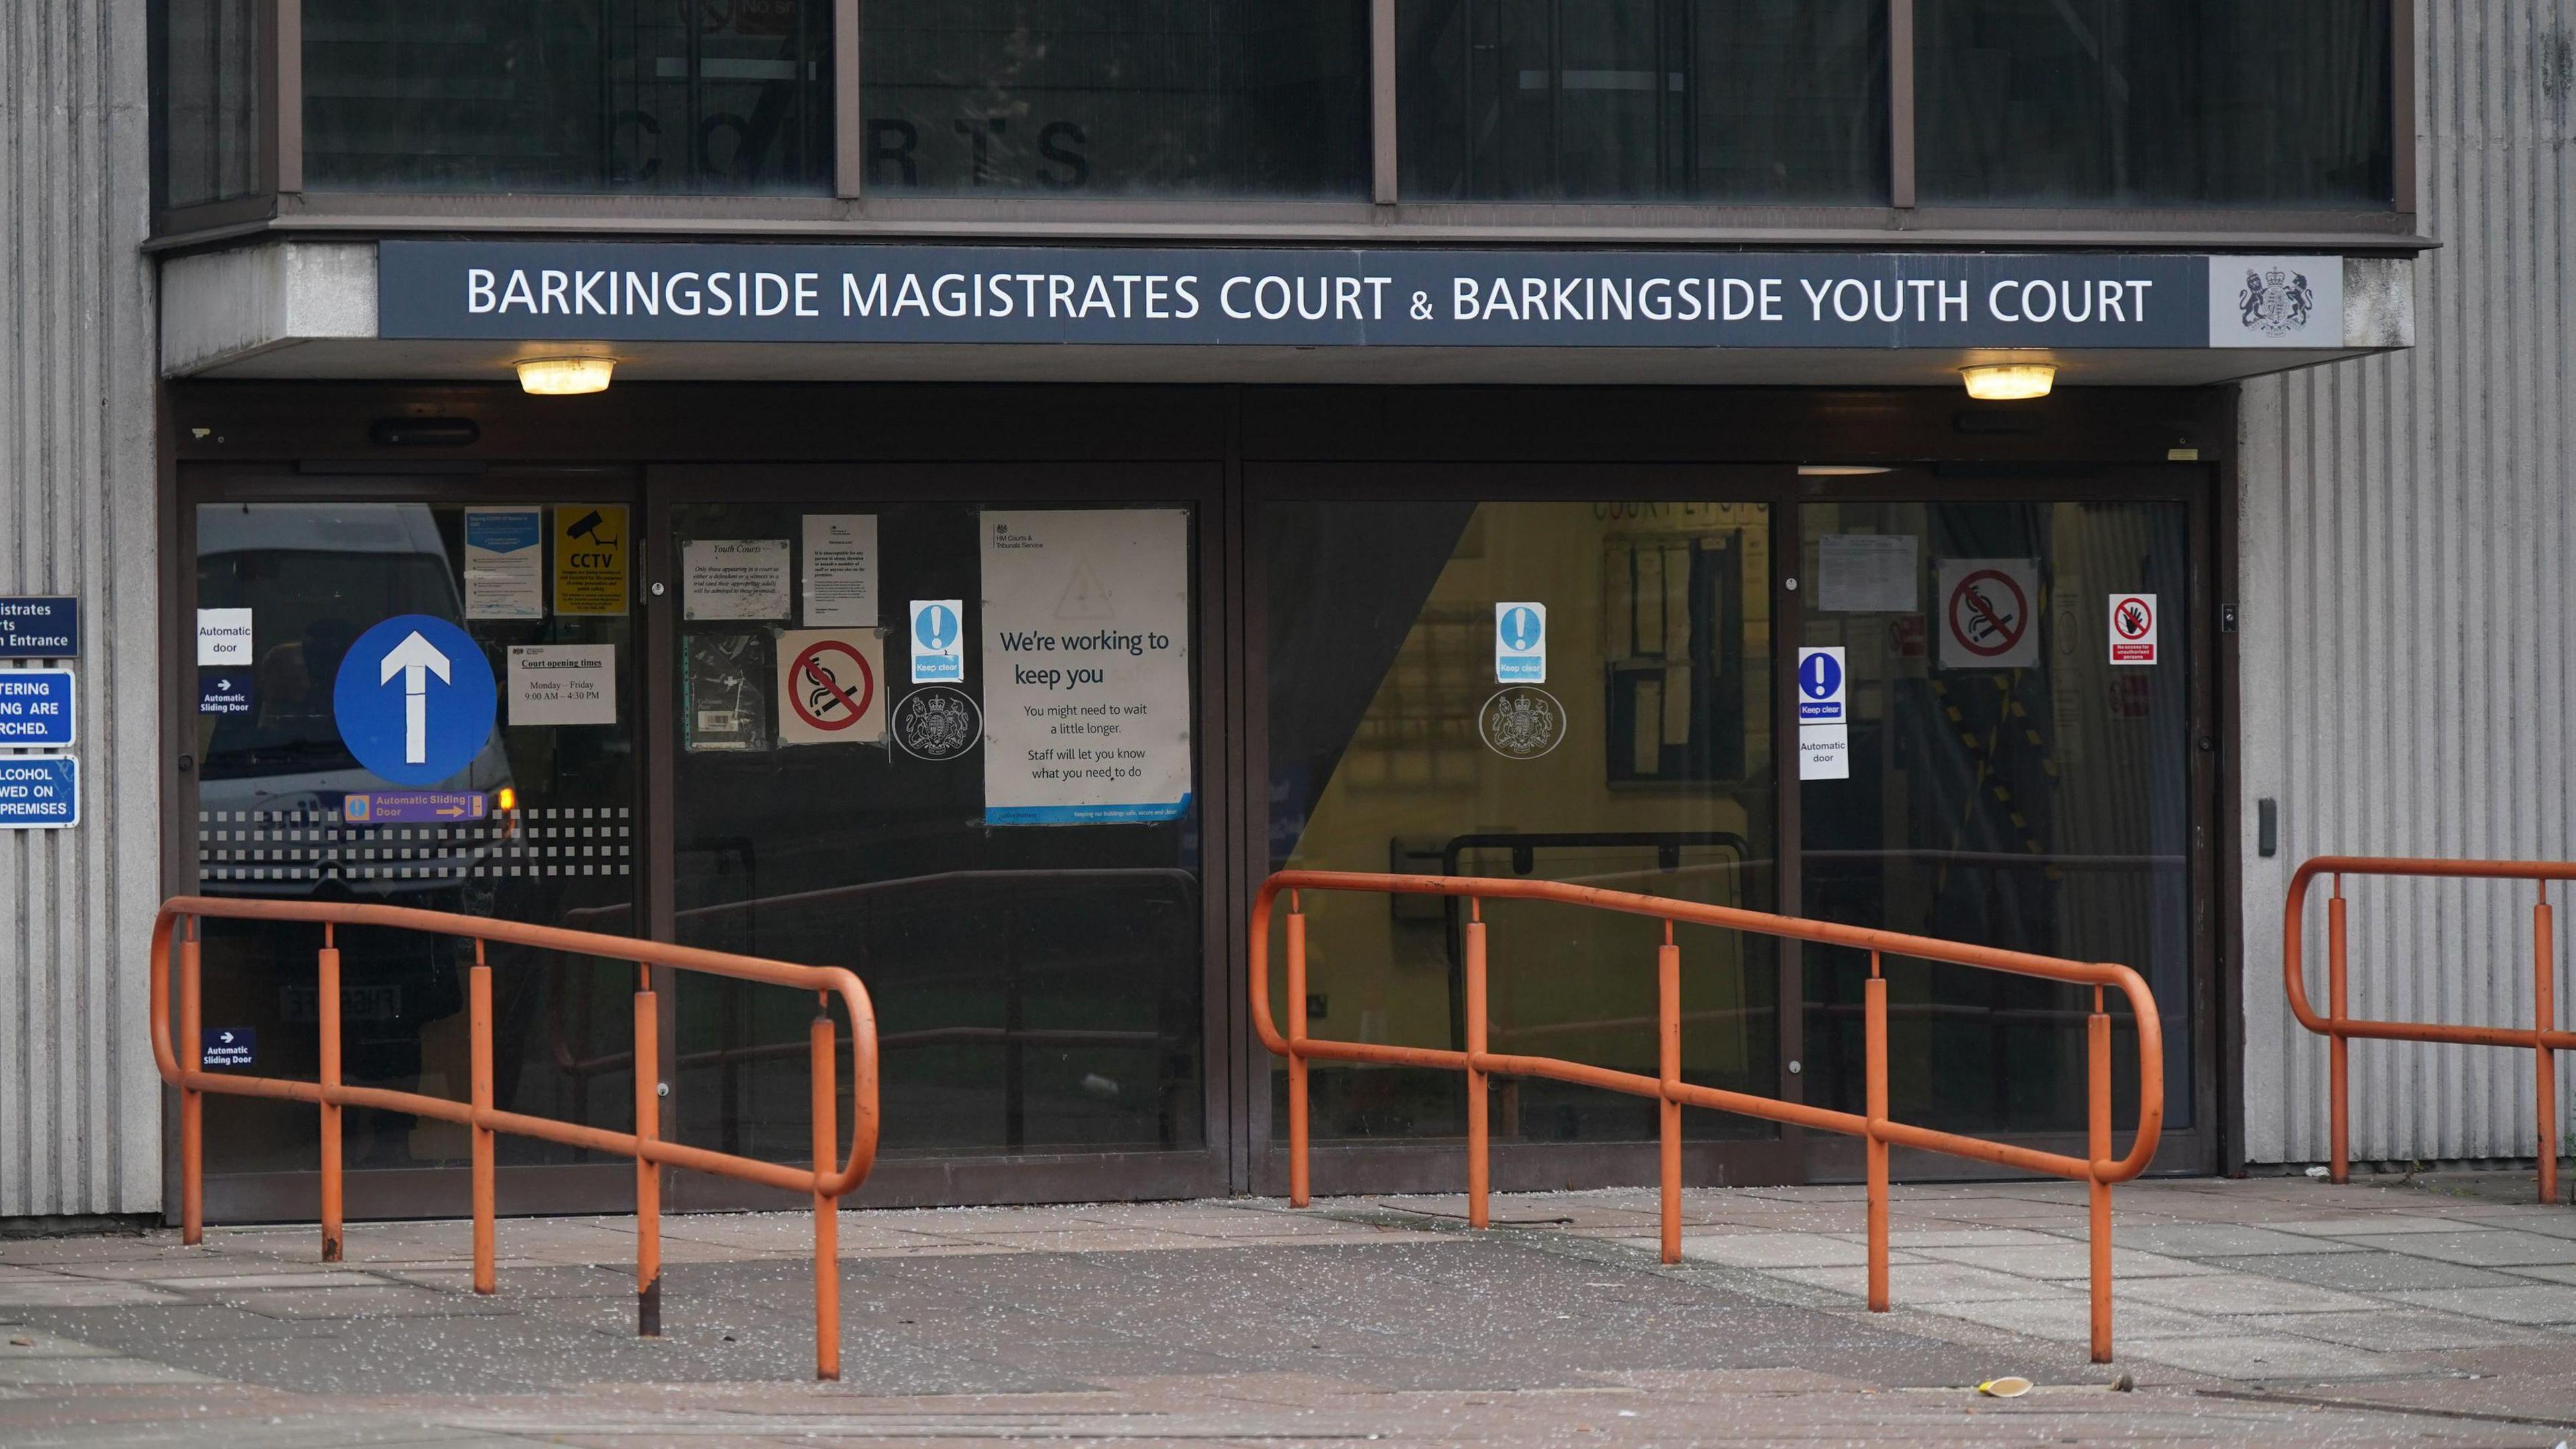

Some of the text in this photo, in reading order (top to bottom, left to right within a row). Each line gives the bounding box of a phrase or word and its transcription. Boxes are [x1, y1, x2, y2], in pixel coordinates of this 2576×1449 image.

[468, 268, 2153, 323] BARKINGSIDE MAGISTRATES COURT & BARKINGSIDE YOUTH COURT
[714, 545, 762, 553] Youth Courts
[570, 553, 612, 568] CCTV
[0, 602, 52, 616] istrates
[199, 626, 252, 636] Automatic
[10, 634, 68, 647] Entrance
[1000, 630, 1169, 655] We're working to
[213, 643, 237, 653] door
[547, 659, 579, 668] opening
[916, 664, 936, 673] Keep
[1501, 663, 1541, 673] Keep clear
[1015, 664, 1104, 690] keep you
[0, 682, 50, 696] TERING
[530, 682, 561, 691] Monday
[570, 681, 594, 690] Friday
[204, 694, 246, 702] Automatic
[0, 702, 59, 715] NG ARE
[200, 703, 249, 713] Sliding Door
[1024, 704, 1148, 719] You might need to wait
[1801, 705, 1840, 714] Keep clear
[0, 722, 48, 735] RCHED.
[1051, 722, 1122, 737] a little longer.
[1801, 741, 1845, 751] Automatic
[1028, 749, 1146, 763] Staff will let you know
[1813, 753, 1834, 763] door
[0, 768, 52, 781] LCOHOL
[1032, 767, 1142, 782] what you need to do
[0, 786, 53, 798] WED ON
[376, 795, 466, 806] Automatic Sliding
[0, 802, 67, 815] PREMISES
[376, 807, 402, 816] Door
[207, 1045, 248, 1055] Automatic
[203, 1055, 252, 1065] Sliding Door
